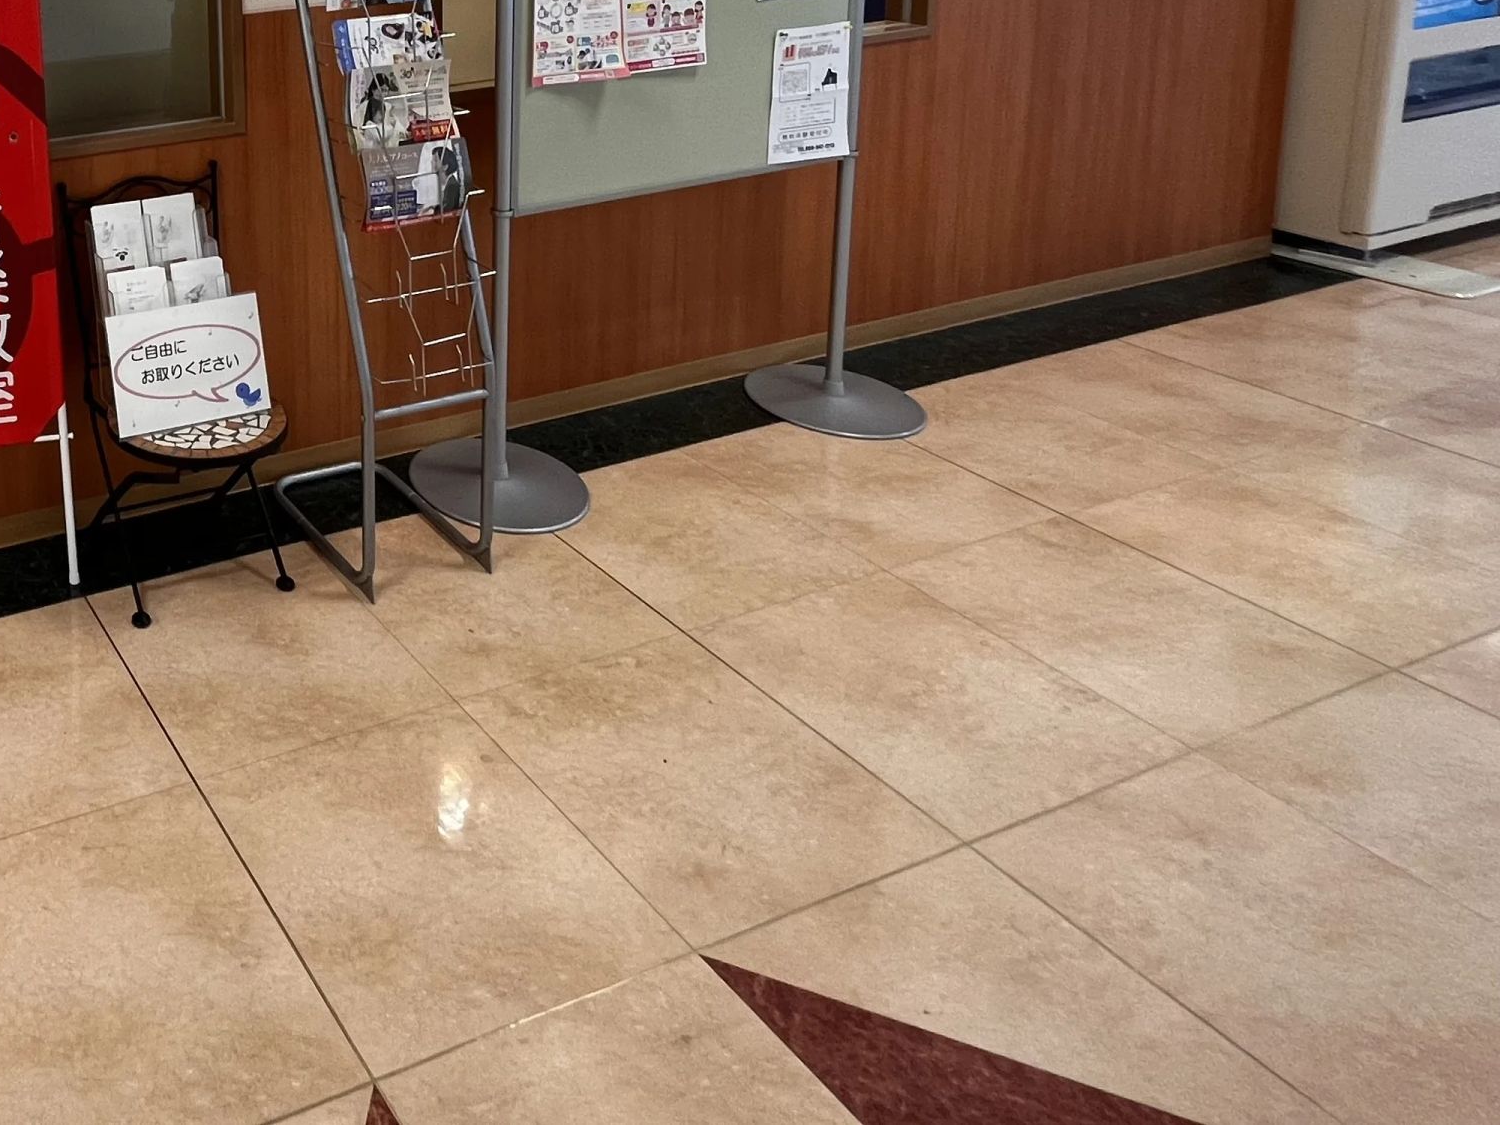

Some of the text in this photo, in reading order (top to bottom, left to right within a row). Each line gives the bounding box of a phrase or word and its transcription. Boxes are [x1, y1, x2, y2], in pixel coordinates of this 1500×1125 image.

[131, 339, 187, 362] ご自由に
[140, 354, 240, 385] お取りください
